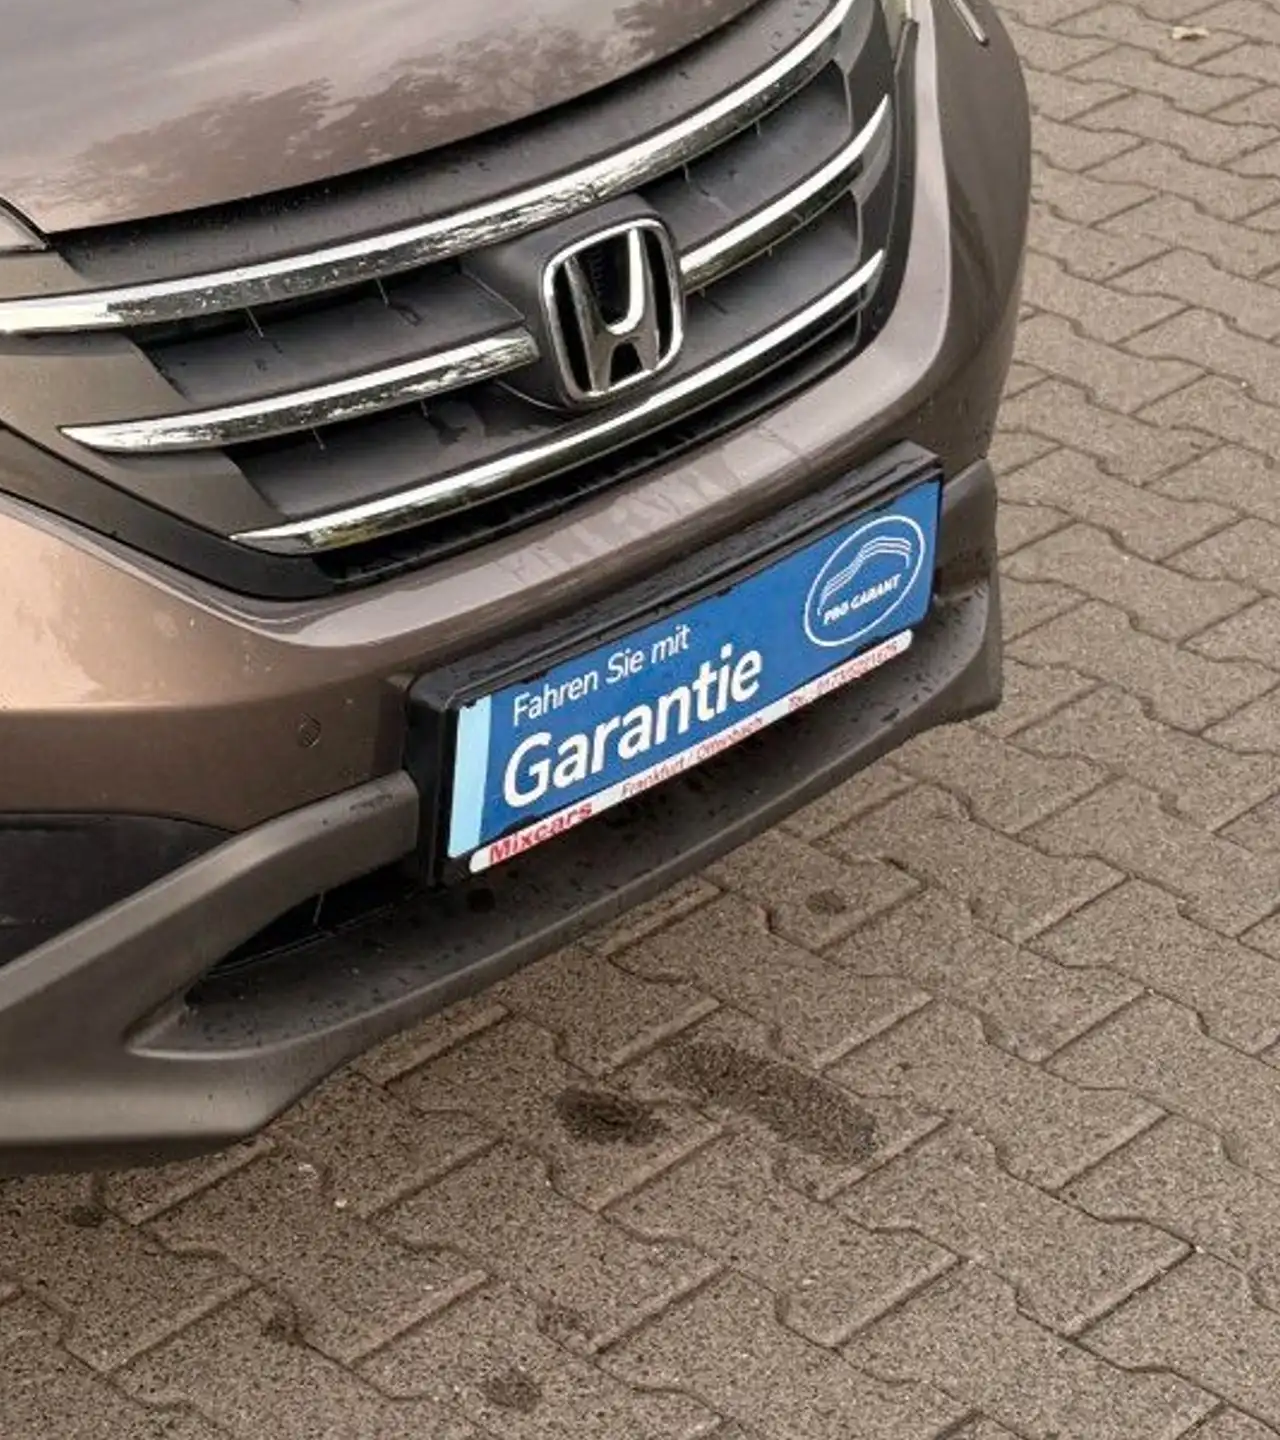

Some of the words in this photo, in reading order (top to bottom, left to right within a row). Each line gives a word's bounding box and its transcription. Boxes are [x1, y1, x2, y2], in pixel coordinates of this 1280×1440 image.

[823, 601, 850, 626] PRO
[850, 572, 902, 610] GARANT
[512, 669, 599, 727] Fahren
[605, 649, 644, 685] Sie
[650, 624, 691, 664] mit
[503, 643, 763, 808] Garantie
[488, 802, 593, 863] Mixcars
